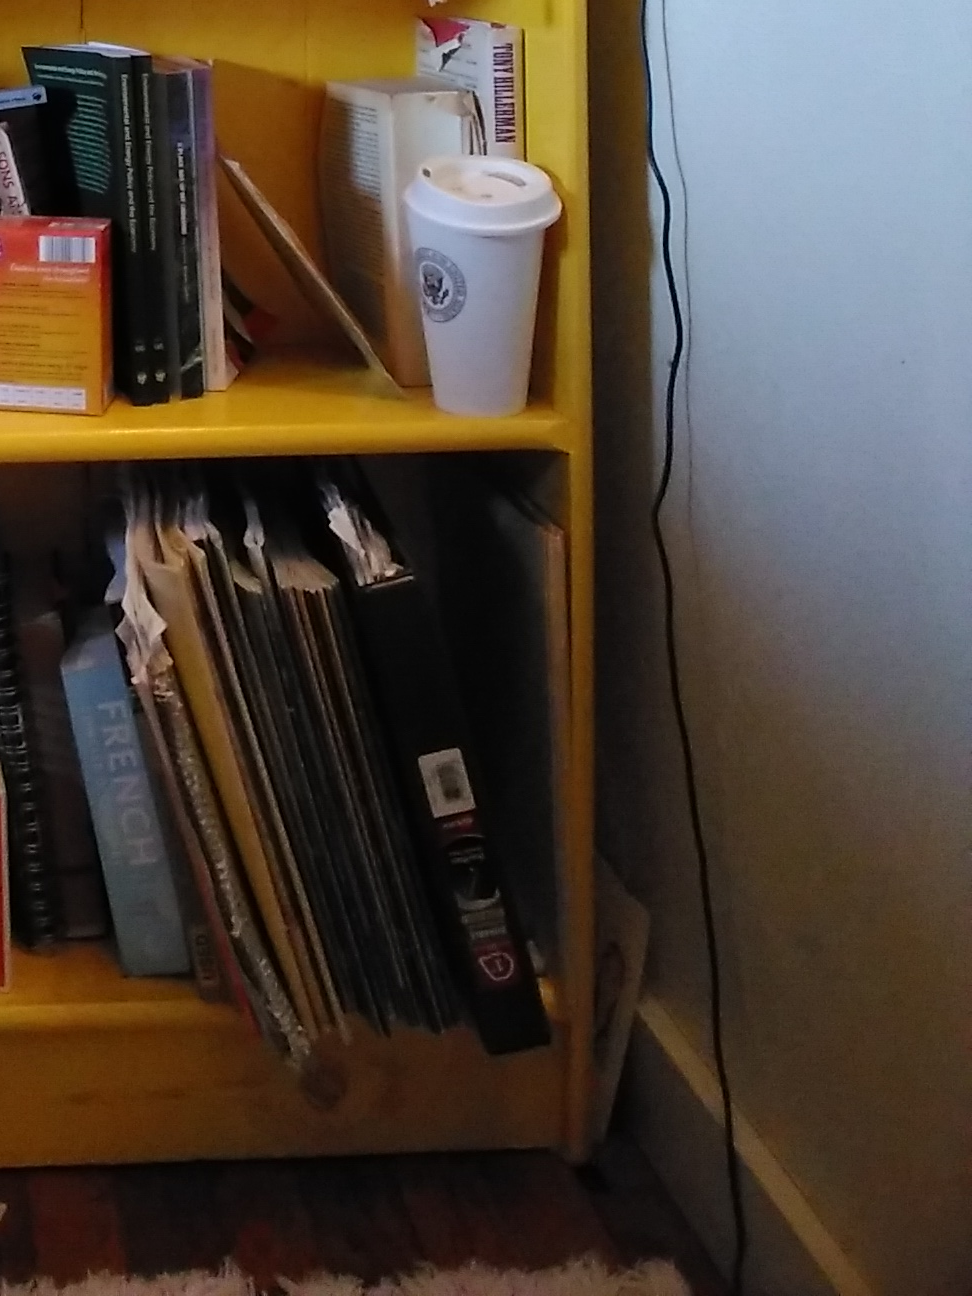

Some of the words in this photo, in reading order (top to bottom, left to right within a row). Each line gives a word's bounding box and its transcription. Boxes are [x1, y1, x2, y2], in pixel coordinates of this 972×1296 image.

[492, 43, 513, 73] TONY
[493, 76, 515, 142] HILLERMAN
[94, 697, 160, 867] FRENCH
